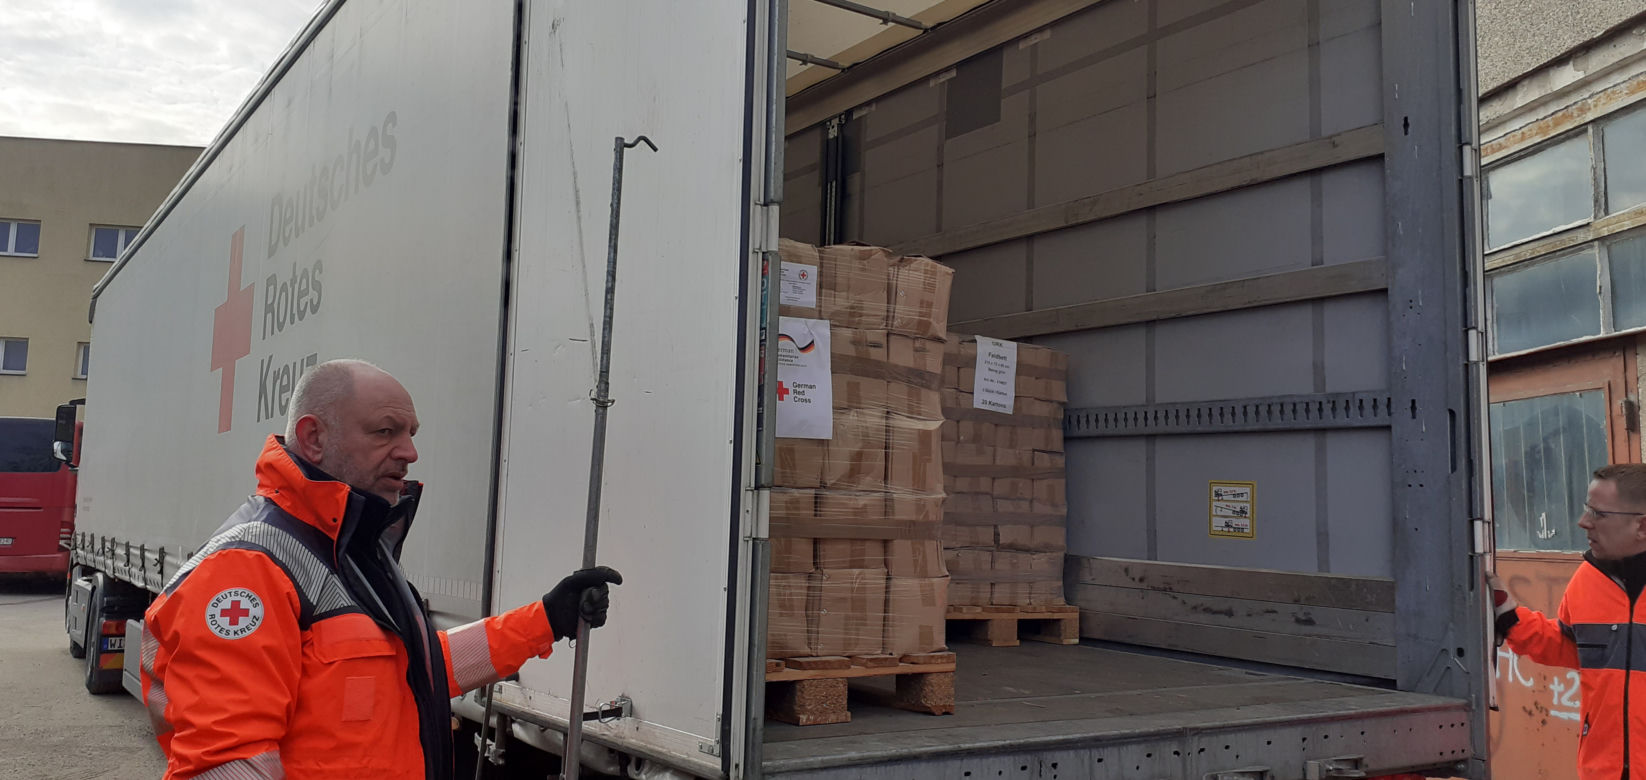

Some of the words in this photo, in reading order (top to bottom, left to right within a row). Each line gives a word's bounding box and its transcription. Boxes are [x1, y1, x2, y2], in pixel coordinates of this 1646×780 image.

[267, 110, 398, 258] Deutsches
[262, 259, 323, 340] Rotes
[209, 613, 231, 637] ROTES
[233, 615, 259, 637] KREUZ
[211, 590, 259, 608] DEUTSCHES
